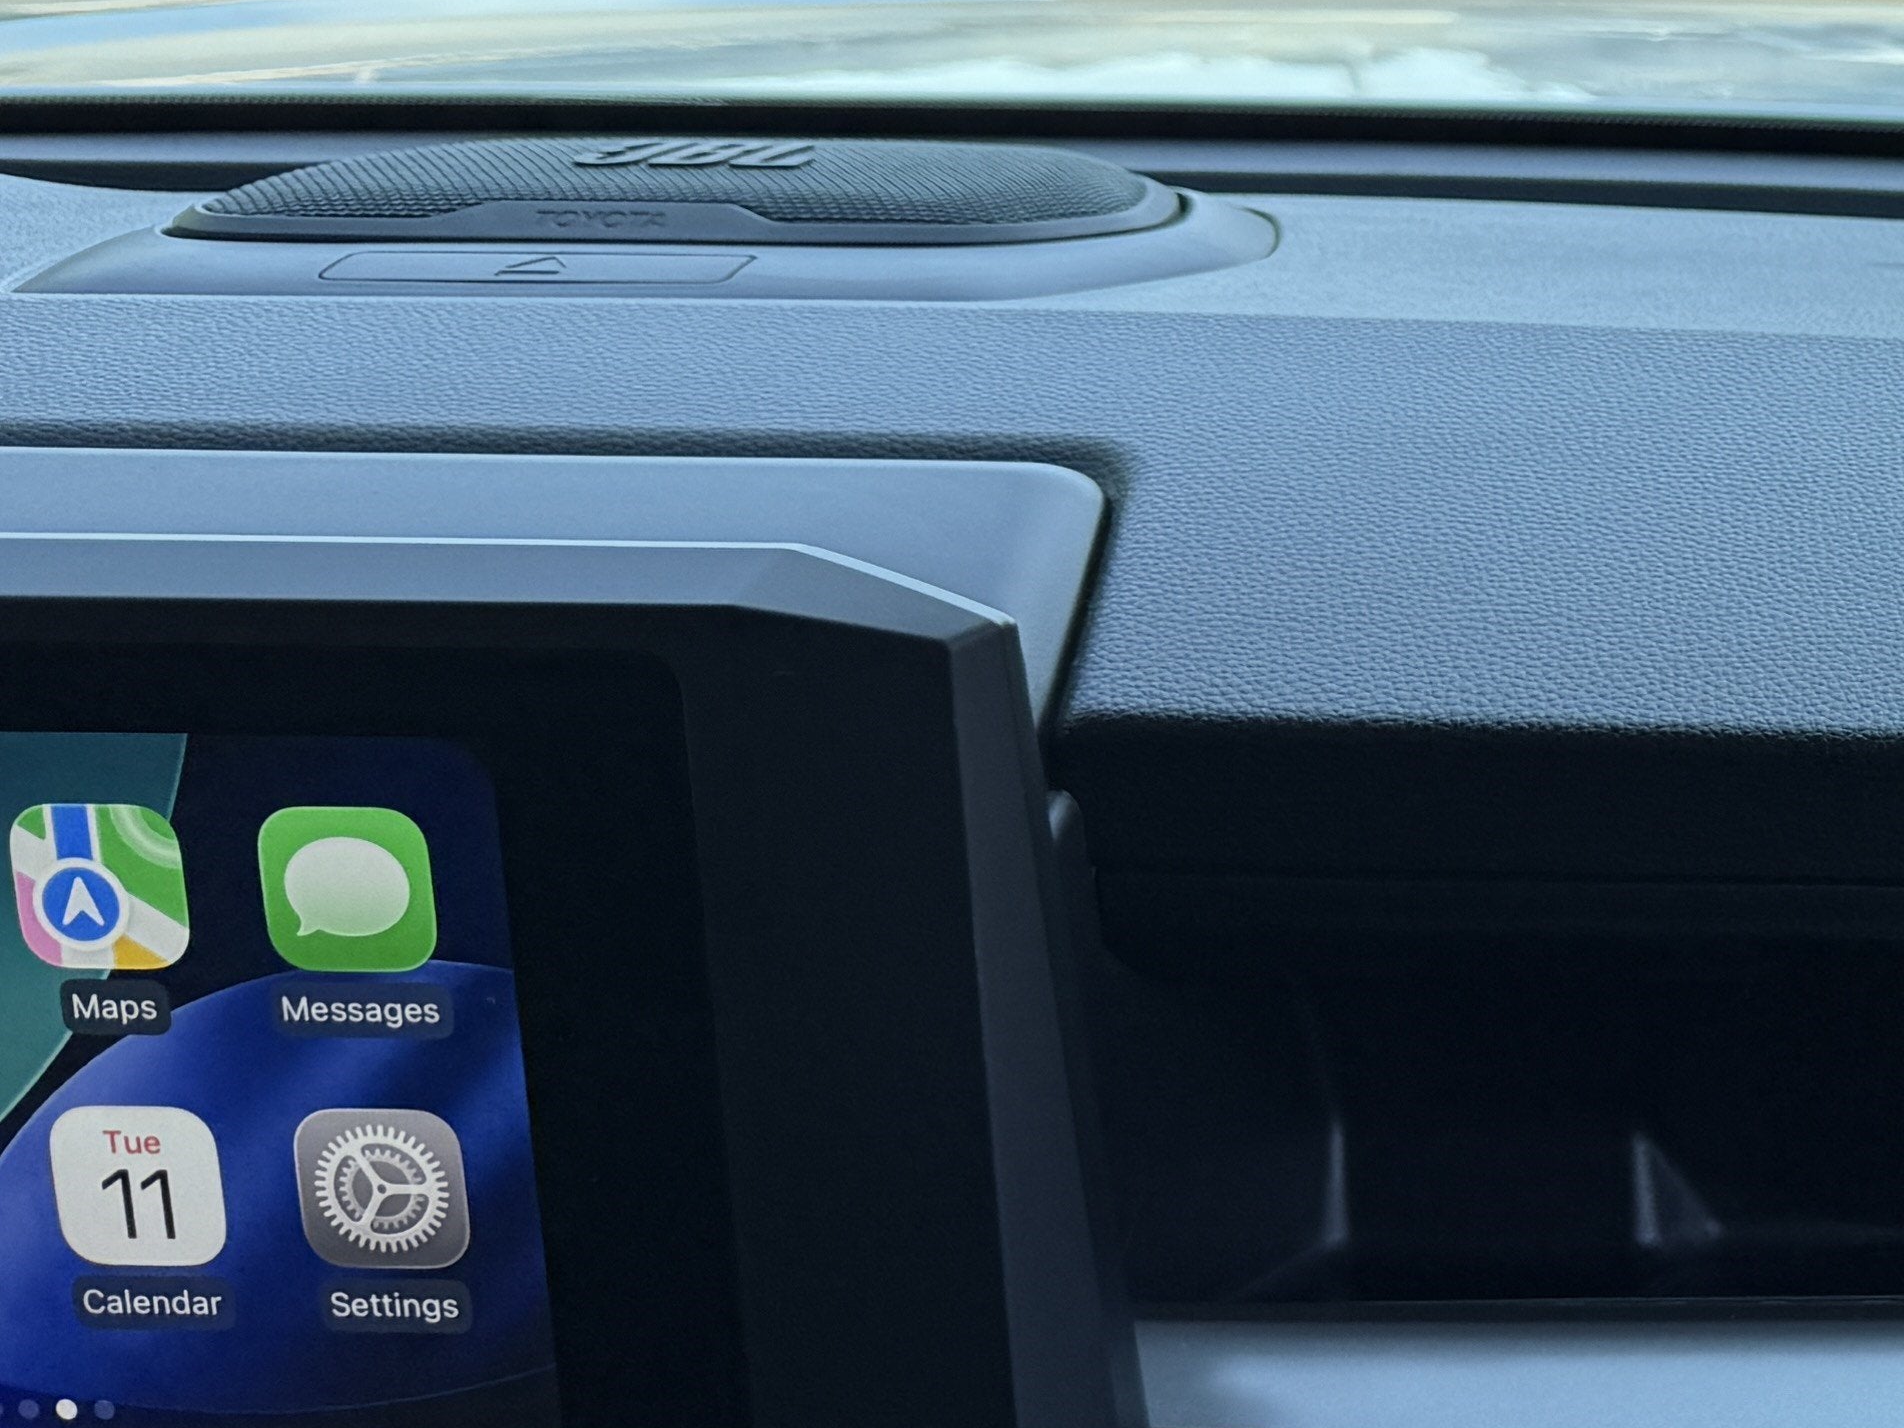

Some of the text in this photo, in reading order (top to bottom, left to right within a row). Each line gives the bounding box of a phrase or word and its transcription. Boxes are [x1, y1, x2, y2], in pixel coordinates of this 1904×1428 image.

[573, 142, 815, 168] JBL
[535, 208, 667, 229] TOYOTA
[72, 993, 157, 1025] Maps
[281, 996, 440, 1029] Messages
[103, 1130, 161, 1155] Tue
[101, 1169, 176, 1240] 11
[83, 1289, 222, 1315] Calendar
[331, 1292, 459, 1323] Settings
